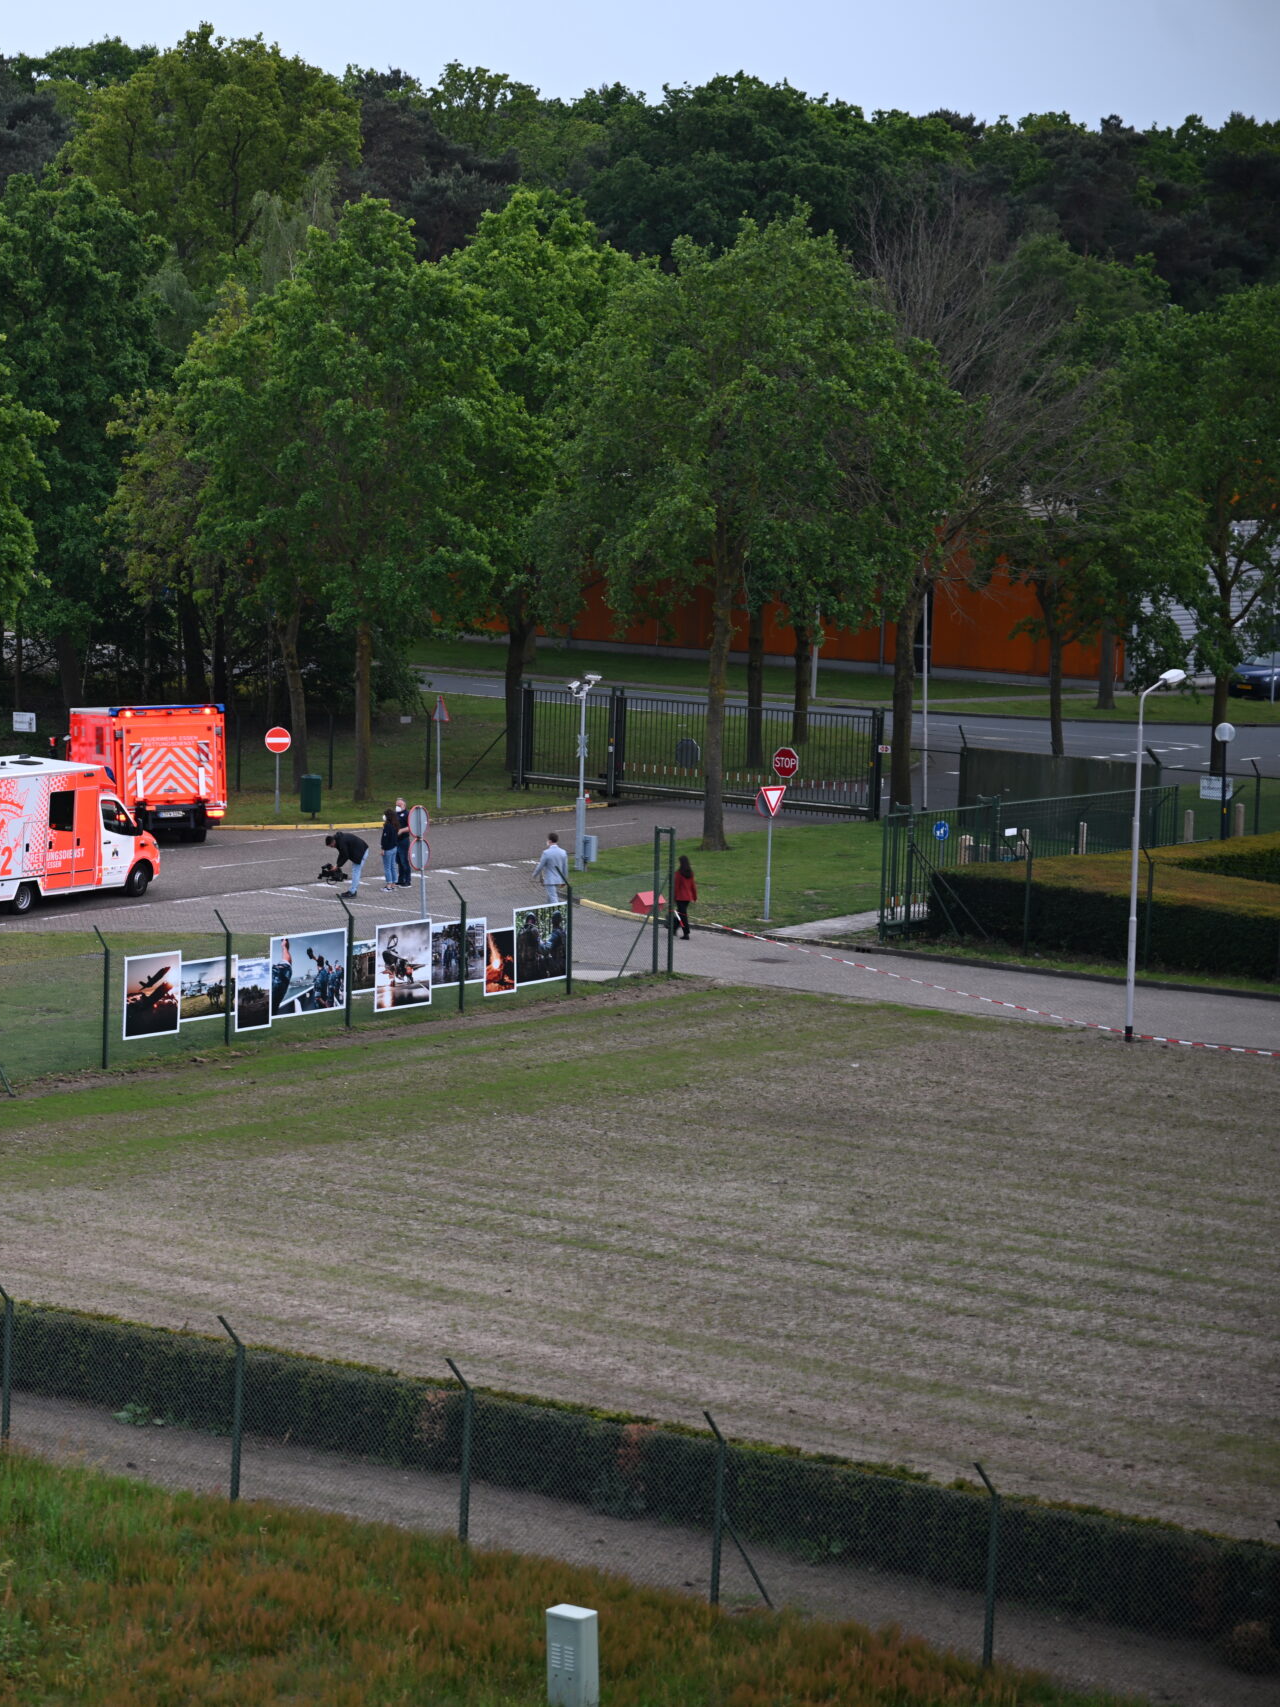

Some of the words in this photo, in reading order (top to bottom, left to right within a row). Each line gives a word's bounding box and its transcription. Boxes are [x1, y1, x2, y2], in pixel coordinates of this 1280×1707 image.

[775, 757, 796, 768] STOP
[30, 848, 85, 863] RETTUNGSDIENST
[47, 861, 62, 869] ESSEN
